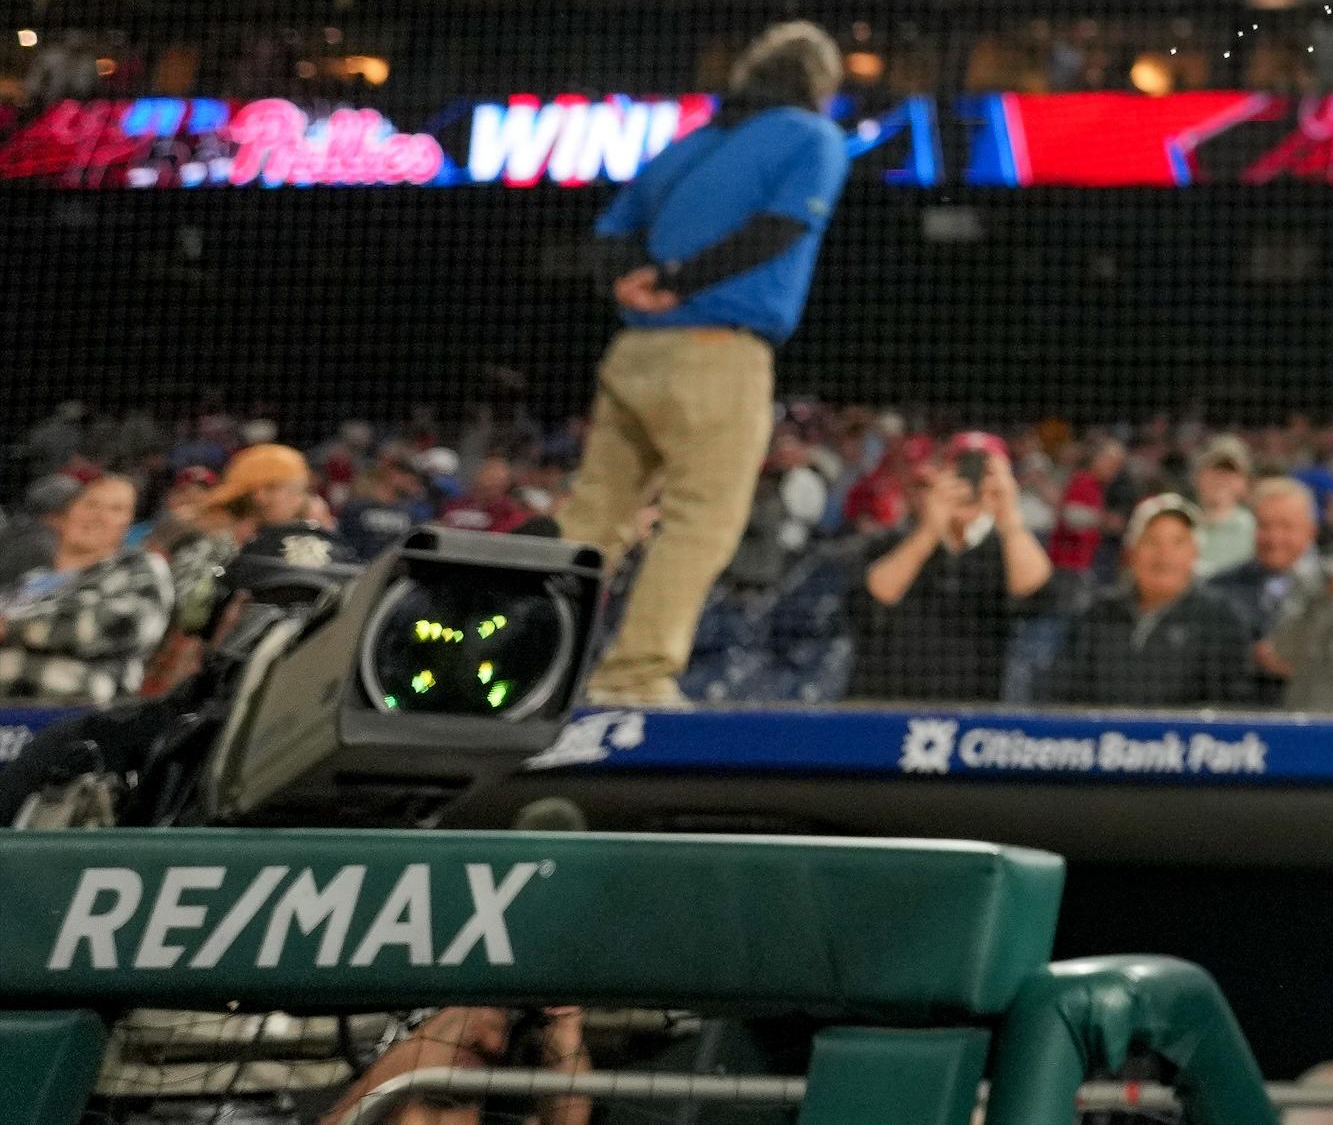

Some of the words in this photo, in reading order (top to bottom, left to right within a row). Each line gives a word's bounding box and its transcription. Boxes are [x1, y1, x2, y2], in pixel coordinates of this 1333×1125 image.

[228, 97, 444, 186] Phillies
[958, 728, 1096, 771] Citizens
[1099, 731, 1185, 774] Bank
[1186, 732, 1267, 775] Park
